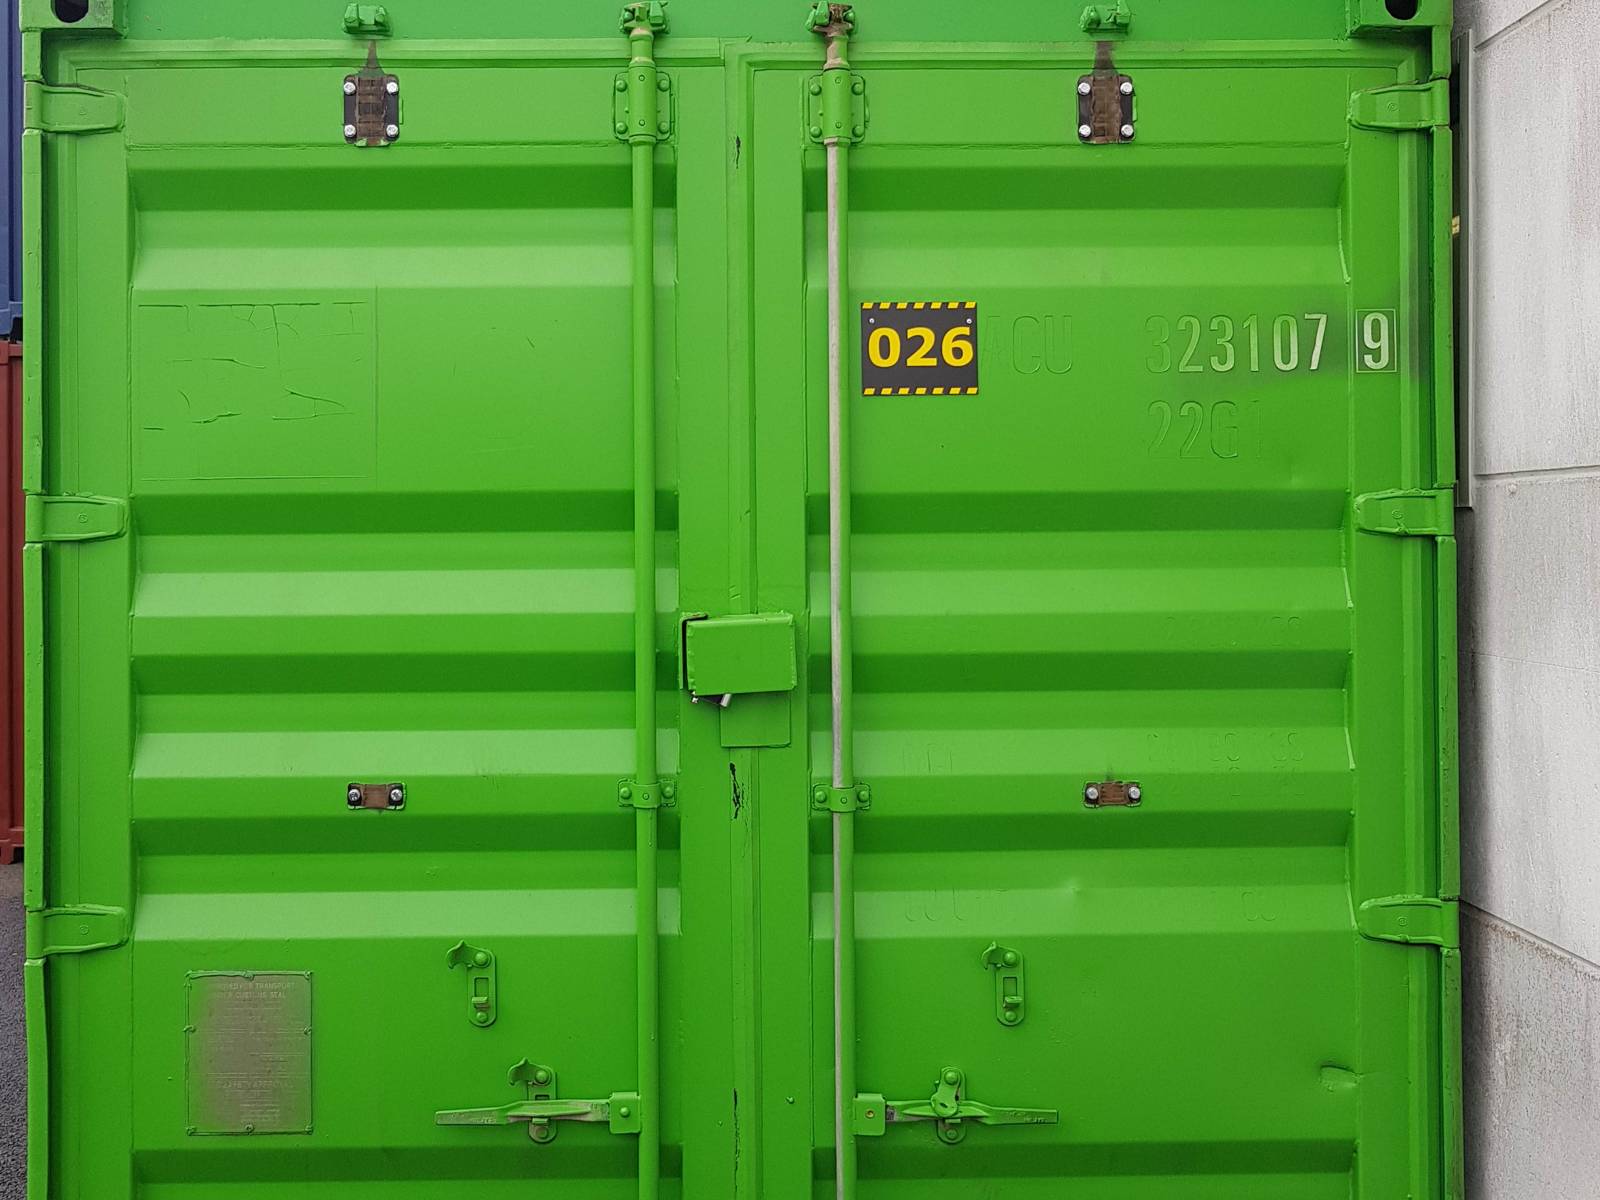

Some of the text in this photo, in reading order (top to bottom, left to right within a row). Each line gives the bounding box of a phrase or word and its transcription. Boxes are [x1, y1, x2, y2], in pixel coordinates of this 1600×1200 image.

[867, 326, 974, 367] 026
[1145, 312, 1328, 373] 323107
[1361, 310, 1391, 372] 9
